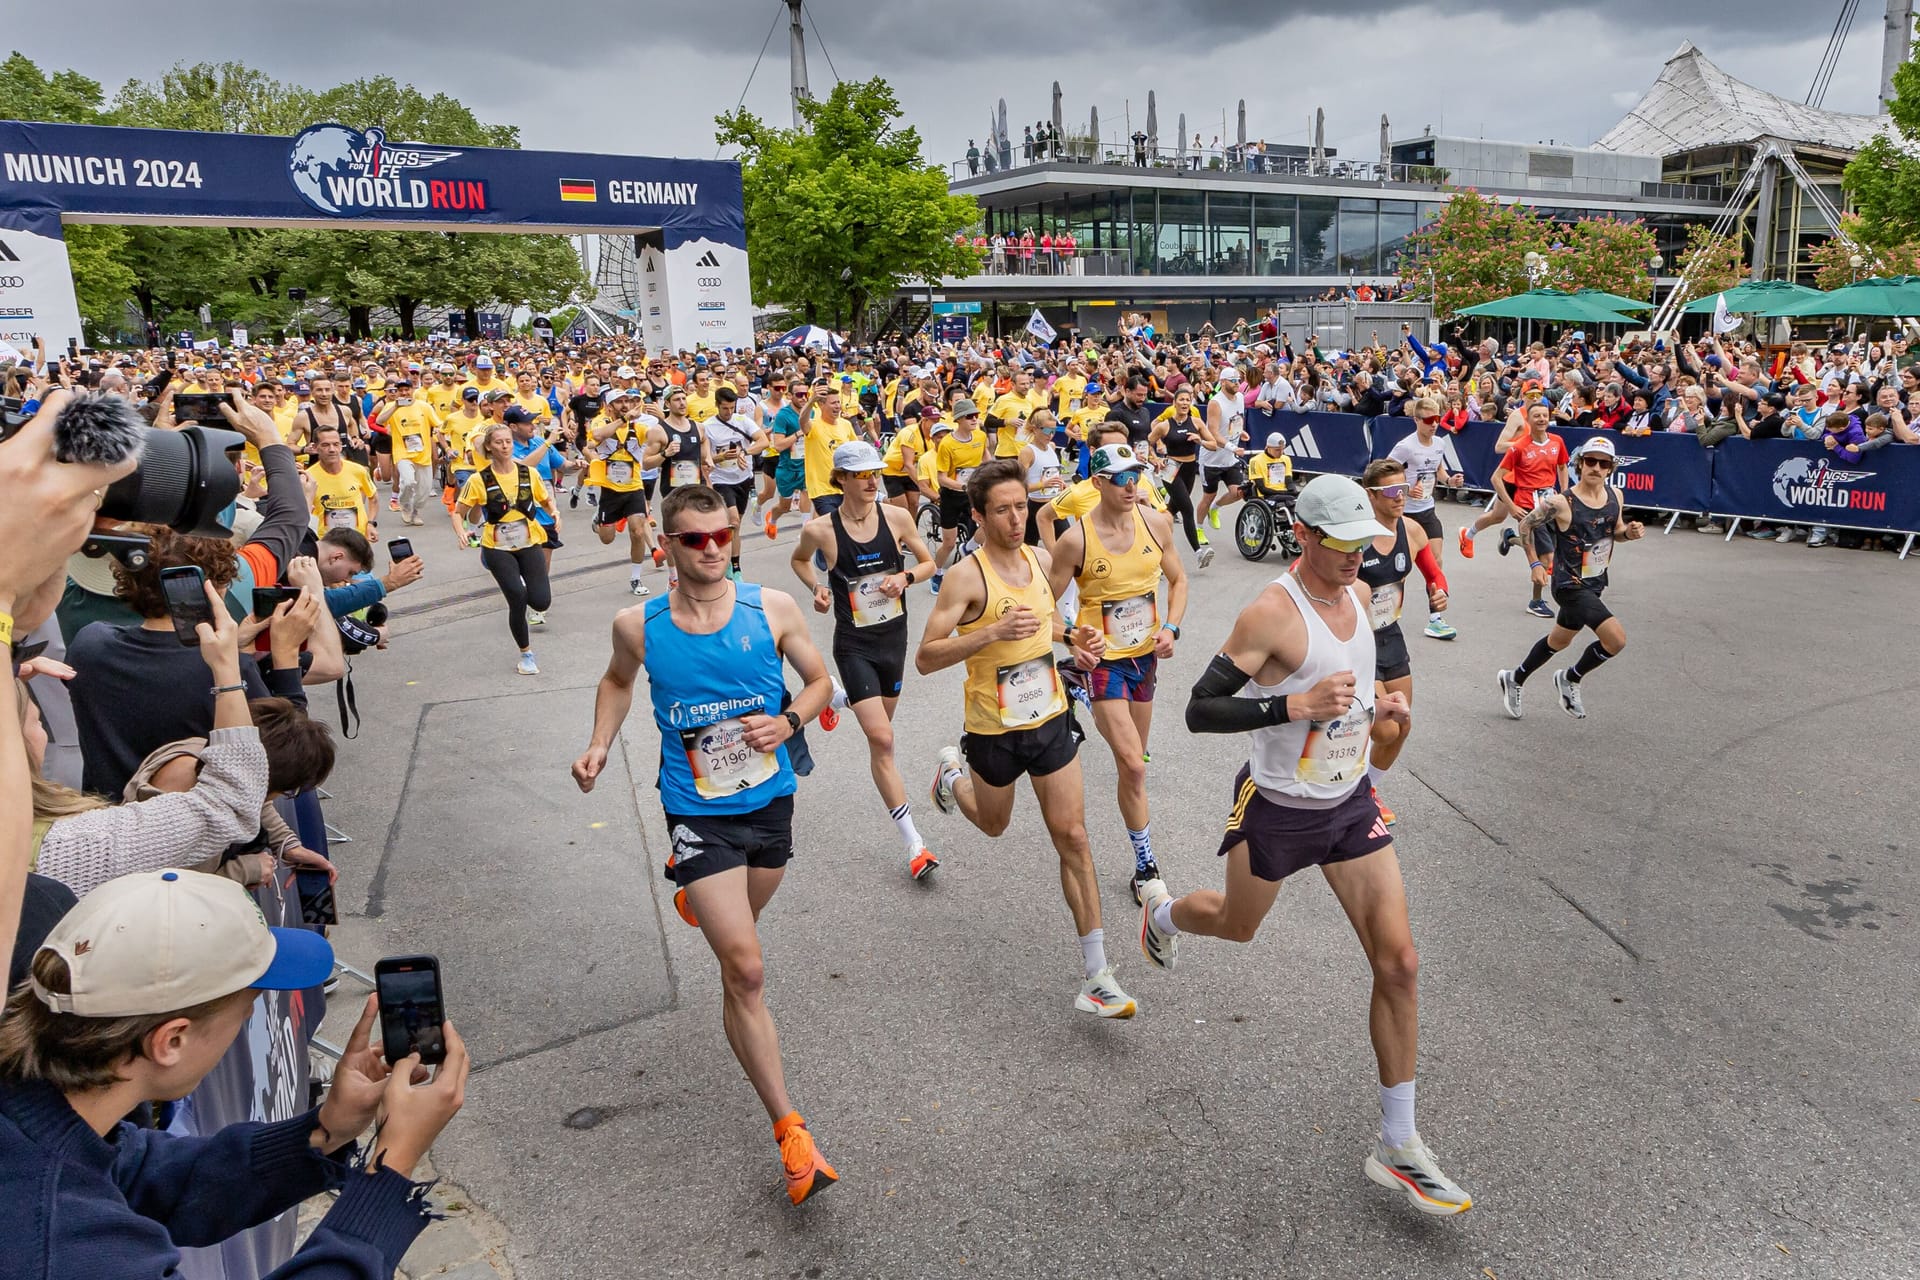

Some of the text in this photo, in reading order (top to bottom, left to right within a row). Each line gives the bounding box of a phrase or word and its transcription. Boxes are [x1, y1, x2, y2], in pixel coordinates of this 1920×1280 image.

[351, 149, 419, 165] WINGS
[4, 153, 203, 189] MUNICH 2024
[348, 163, 364, 171] FOR
[363, 164, 400, 178] LIFE
[326, 176, 486, 210] WORLD RUN
[608, 180, 698, 206] GERMANY
[1627, 472, 1655, 491] RUN
[1807, 470, 1849, 481] WINGS
[1811, 480, 1836, 489] LIFE
[1790, 485, 1886, 511] WORLD RUN
[690, 694, 765, 715] engelhorn
[692, 712, 728, 724] SPORTS
[710, 745, 753, 771] 21967
